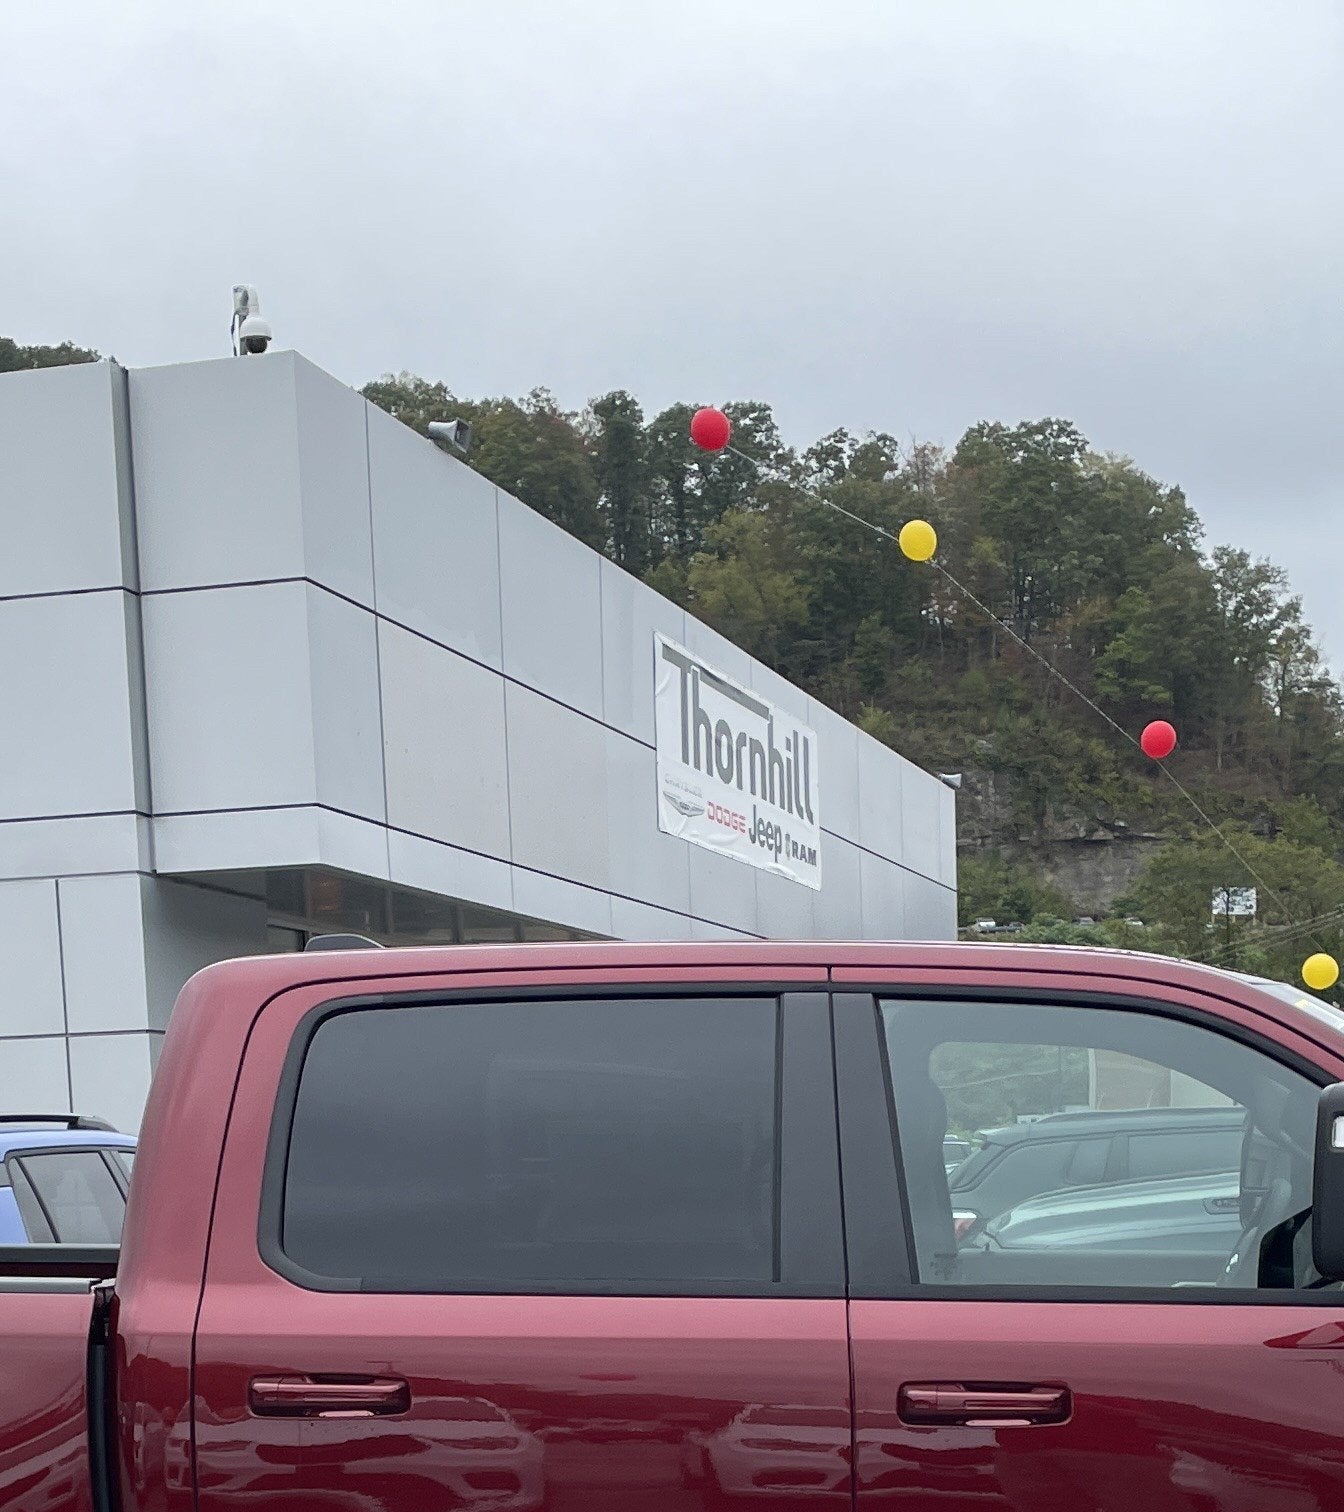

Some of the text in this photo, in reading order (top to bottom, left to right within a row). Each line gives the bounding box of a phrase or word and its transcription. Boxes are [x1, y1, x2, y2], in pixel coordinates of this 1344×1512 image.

[661, 642, 815, 826] Thornhill
[707, 800, 817, 867] DODGE Jeep RAM
